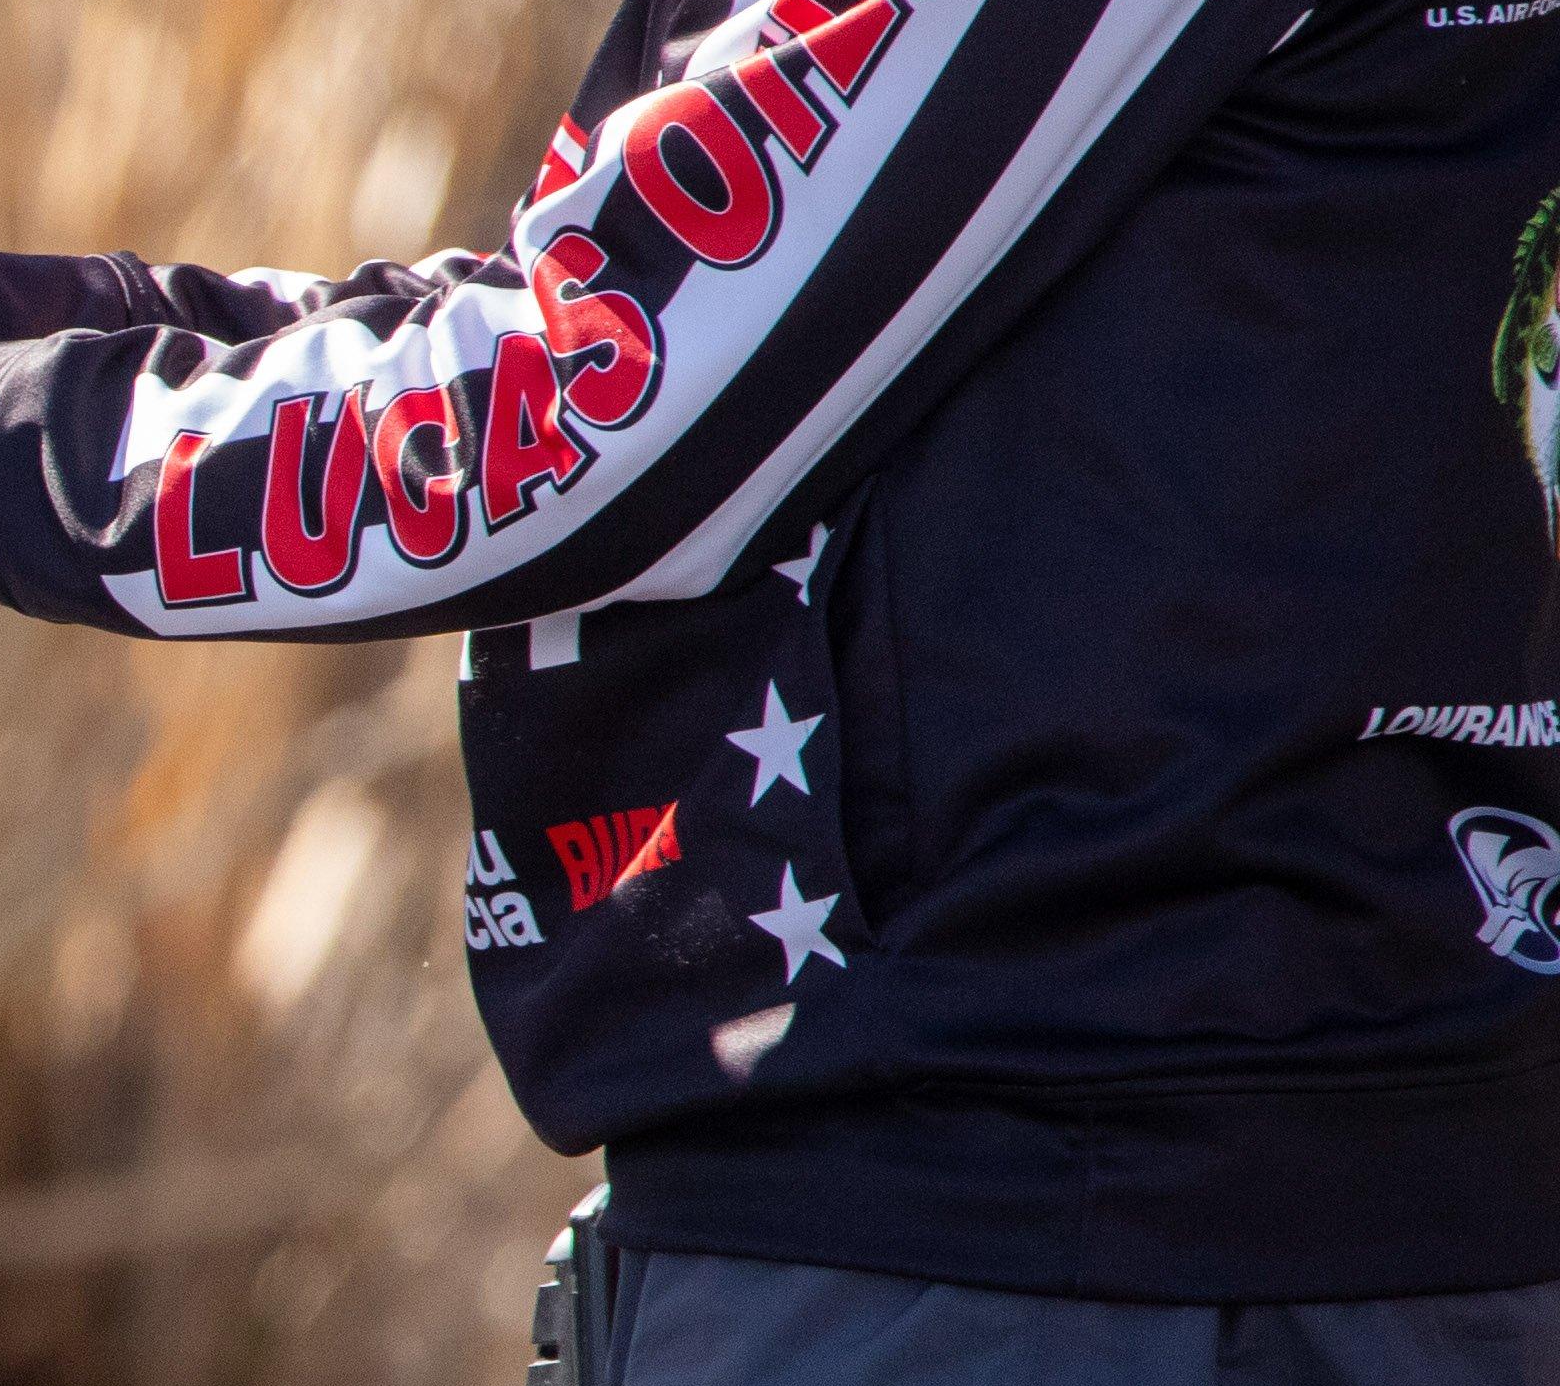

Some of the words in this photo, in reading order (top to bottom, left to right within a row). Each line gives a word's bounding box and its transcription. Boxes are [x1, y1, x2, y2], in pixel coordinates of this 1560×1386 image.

[1426, 5, 1484, 28] U.S.
[1487, 3, 1529, 24] AIR
[153, 223, 664, 610] LUCAS
